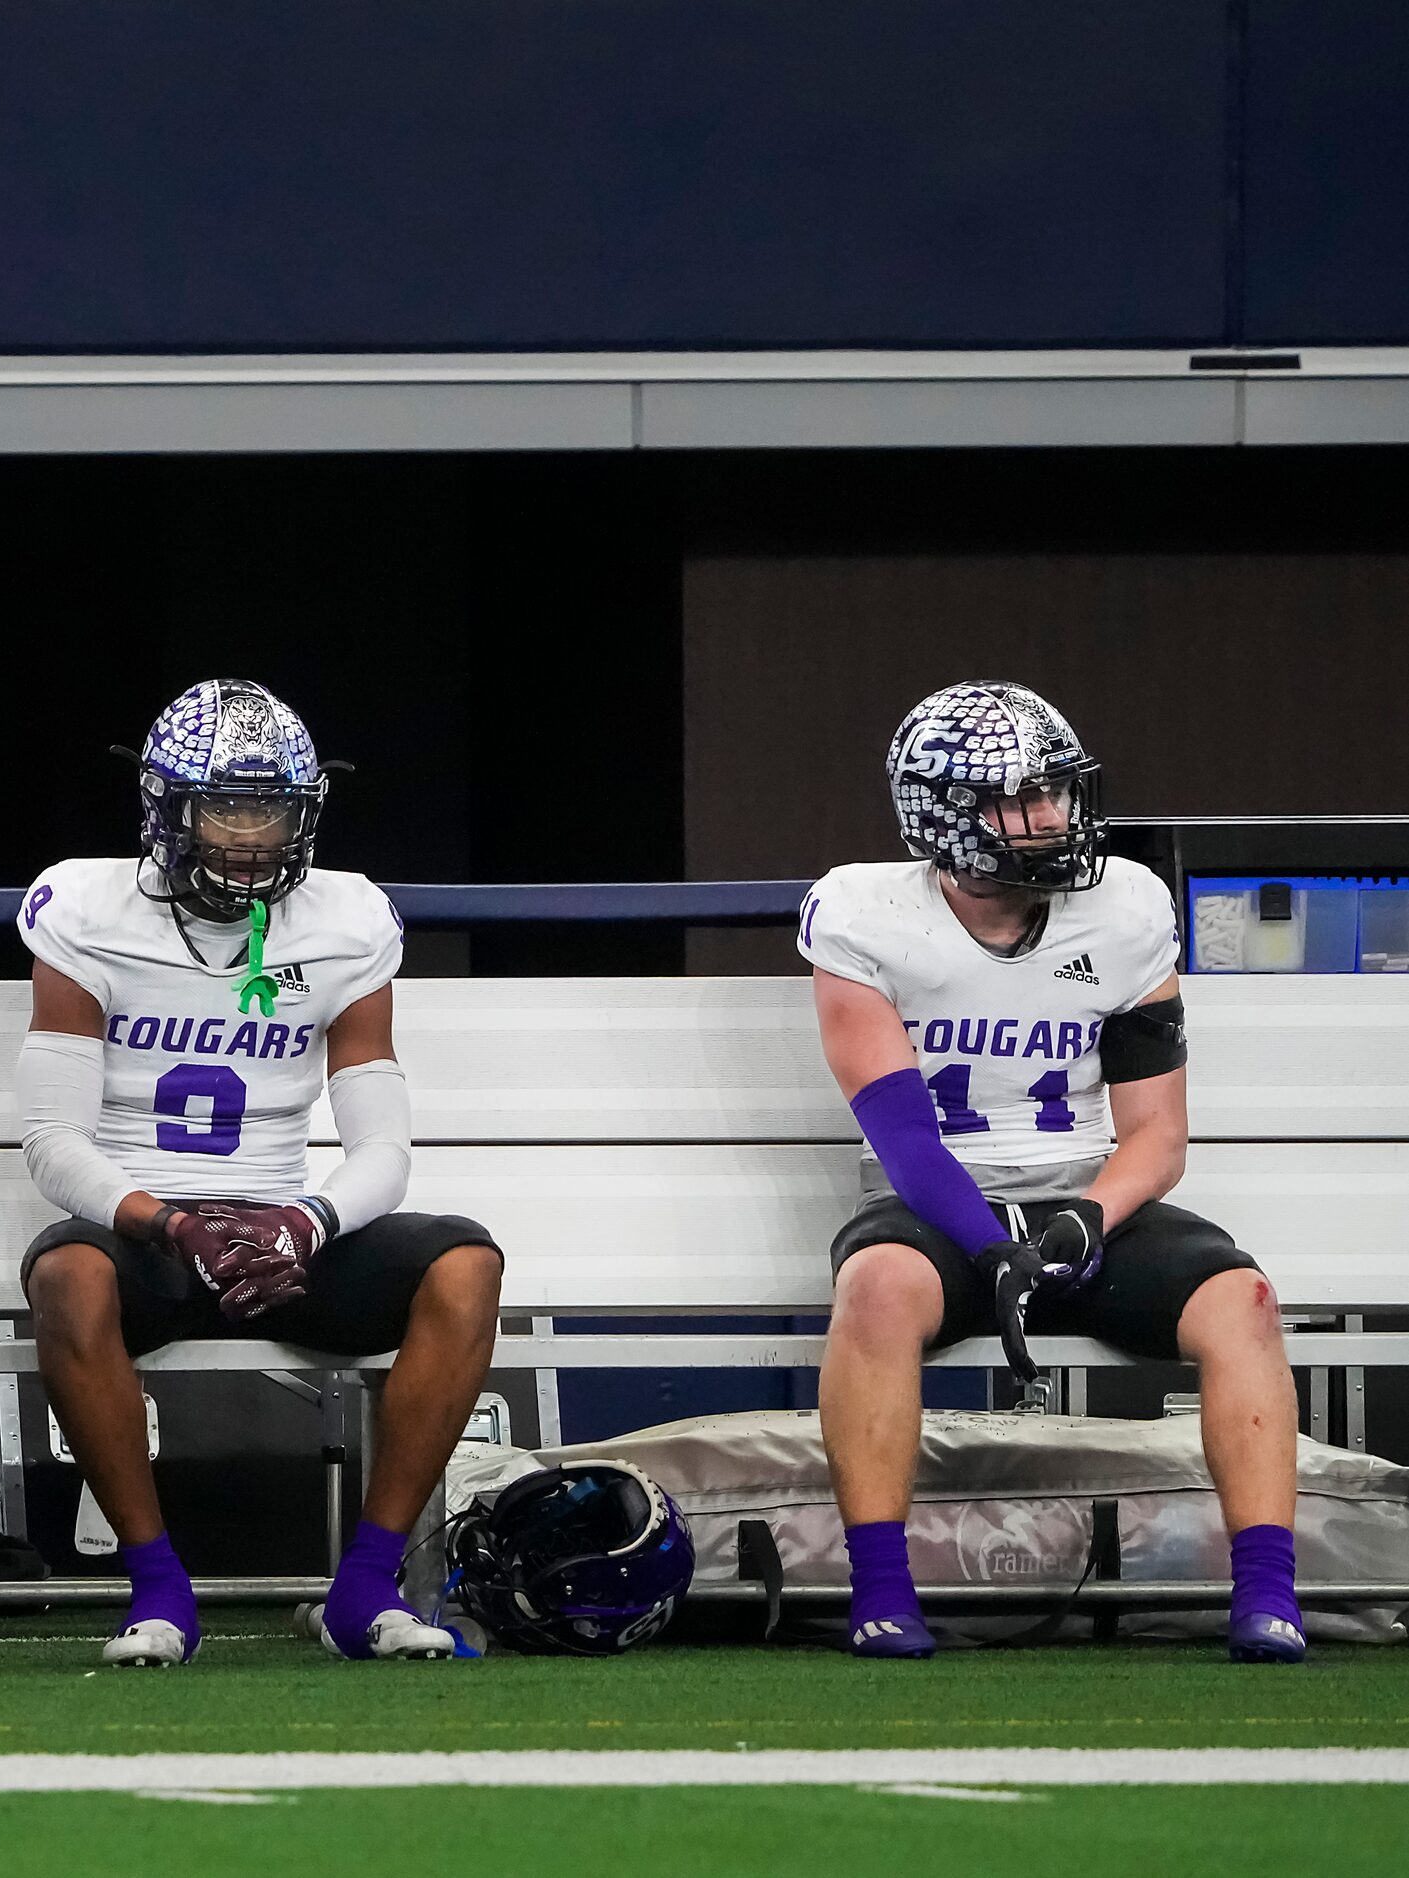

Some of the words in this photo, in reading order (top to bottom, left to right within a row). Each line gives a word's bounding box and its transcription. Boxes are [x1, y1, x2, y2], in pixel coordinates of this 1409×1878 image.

[25, 885, 53, 930] 9
[275, 977, 311, 994] didas
[1053, 969, 1100, 986] adidas
[108, 1014, 315, 1060] COUGARS
[153, 1063, 247, 1156] 9
[927, 1063, 1076, 1136] 11
